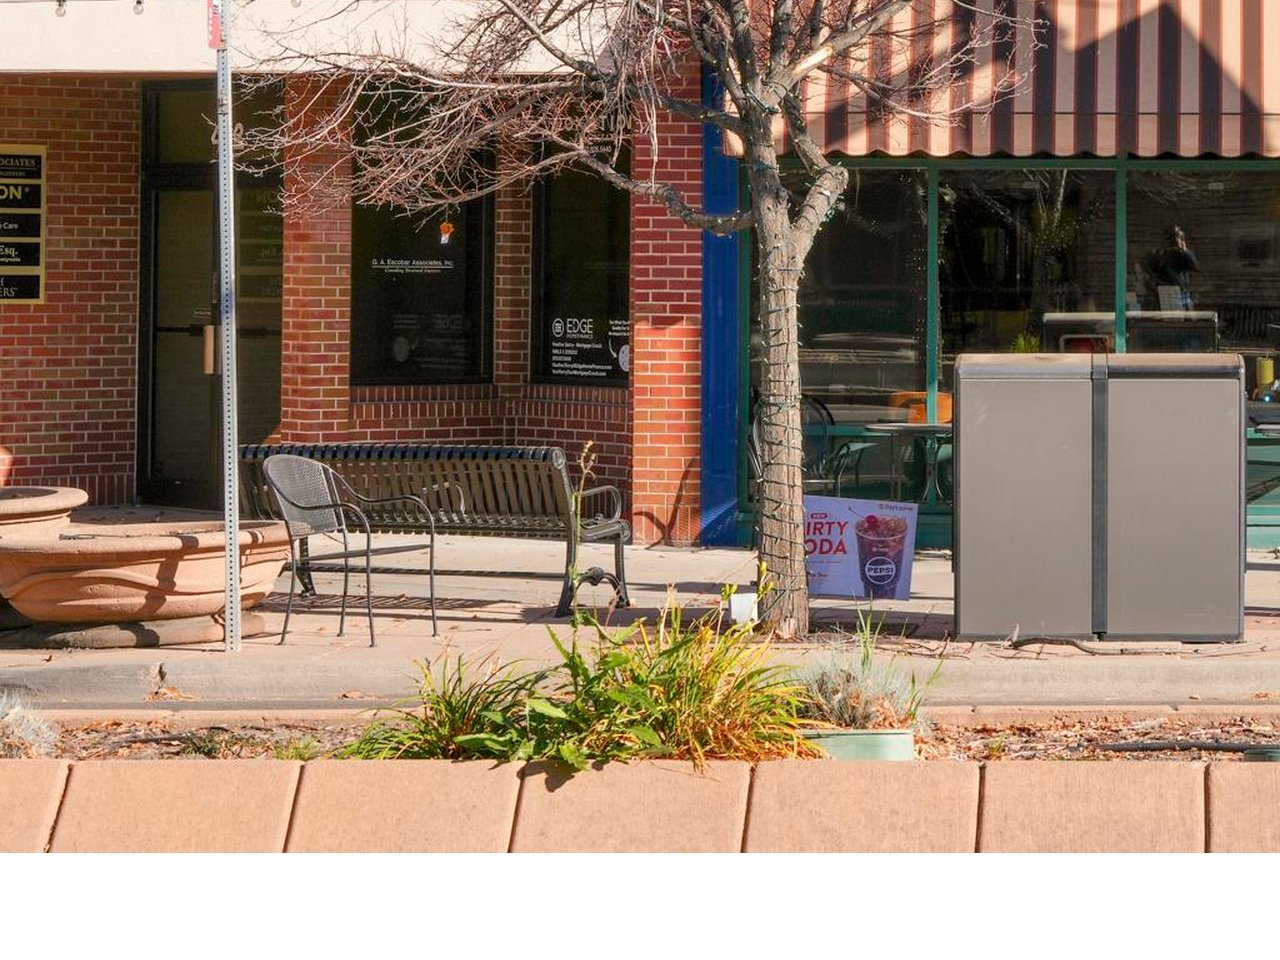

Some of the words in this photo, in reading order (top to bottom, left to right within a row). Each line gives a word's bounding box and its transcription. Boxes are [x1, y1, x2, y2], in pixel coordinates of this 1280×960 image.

[566, 318, 593, 333] EDGE
[803, 521, 848, 536] IRTY
[803, 539, 848, 555] ODA
